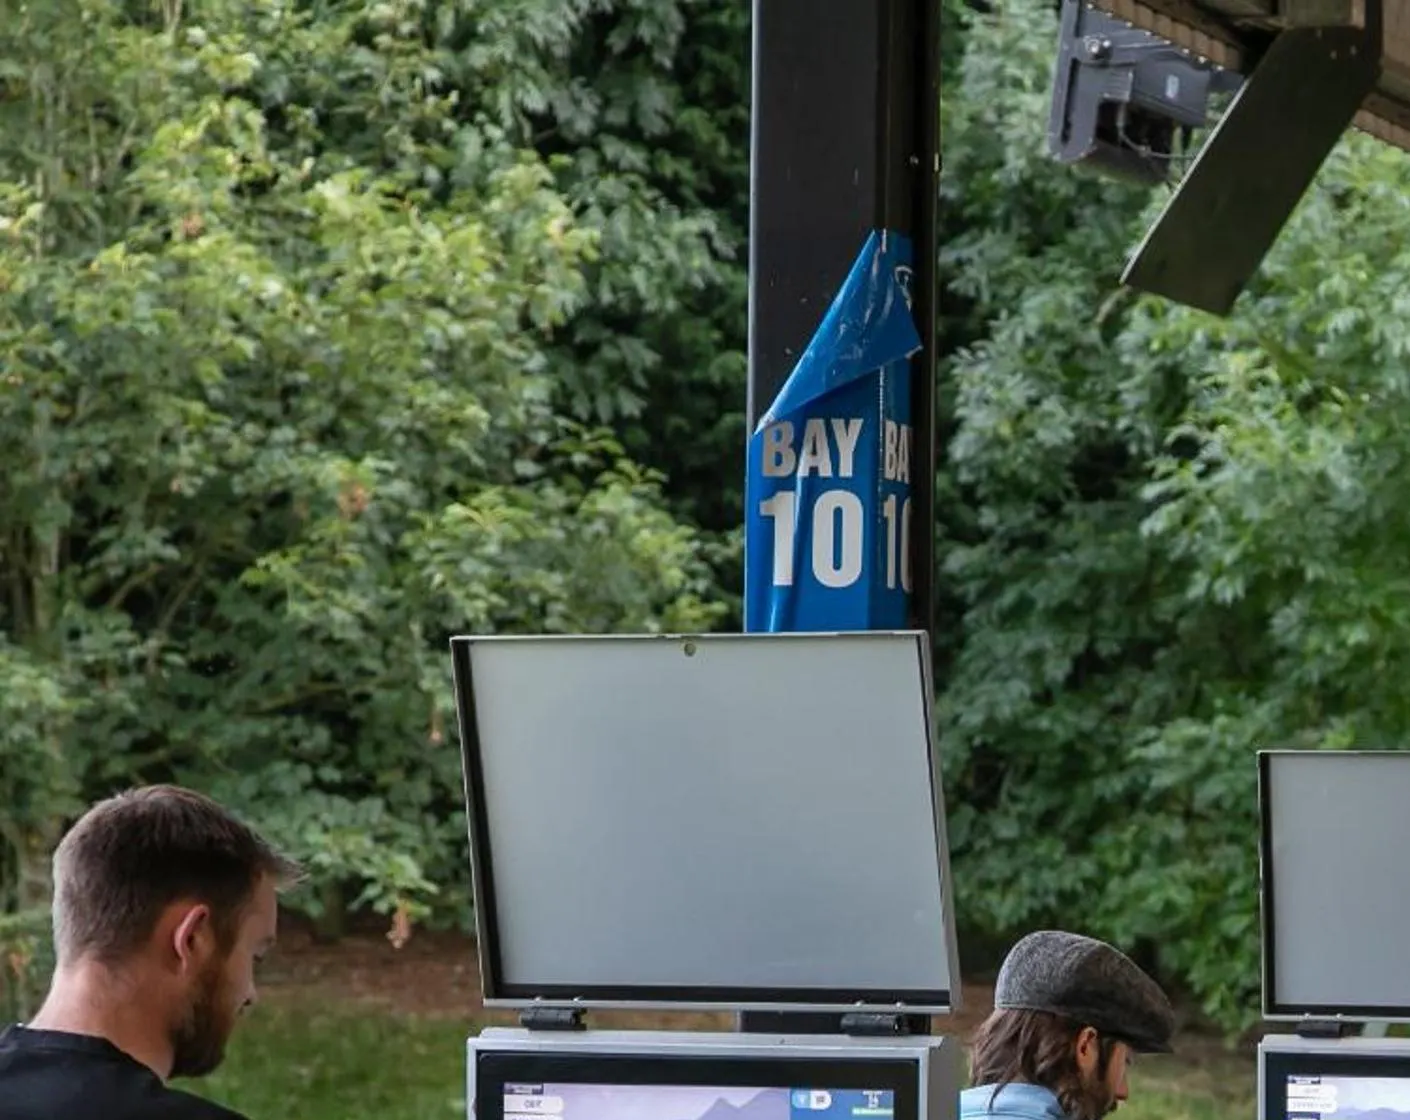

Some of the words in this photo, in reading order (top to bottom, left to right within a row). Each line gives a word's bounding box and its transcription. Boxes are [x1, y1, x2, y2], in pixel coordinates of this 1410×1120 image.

[762, 418, 864, 477] BAY
[884, 420, 912, 484] BA
[759, 489, 864, 588] 10
